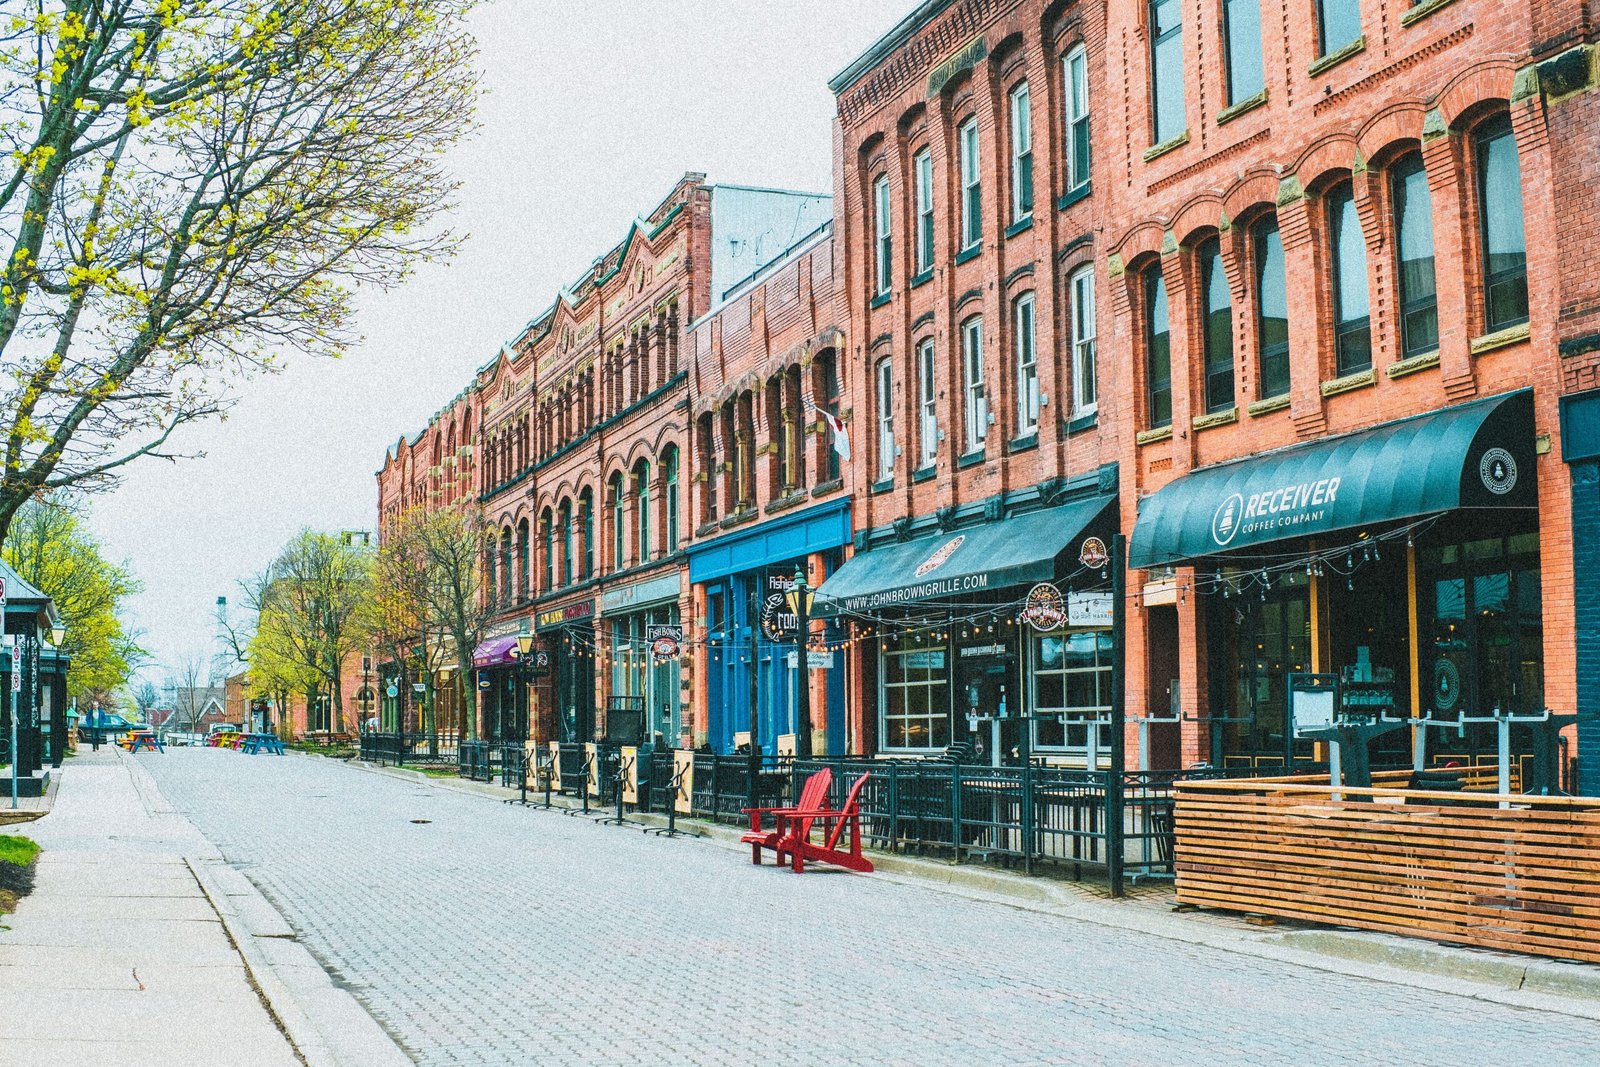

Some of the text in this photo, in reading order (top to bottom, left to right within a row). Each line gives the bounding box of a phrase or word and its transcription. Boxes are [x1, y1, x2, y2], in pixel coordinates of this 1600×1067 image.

[1244, 477, 1341, 519] RECEIVER
[1242, 510, 1325, 534] COFFEE COMPANY
[769, 576, 794, 589] Fishie
[845, 573, 988, 611] WWW.JOHNBROWNGRILLE.COM
